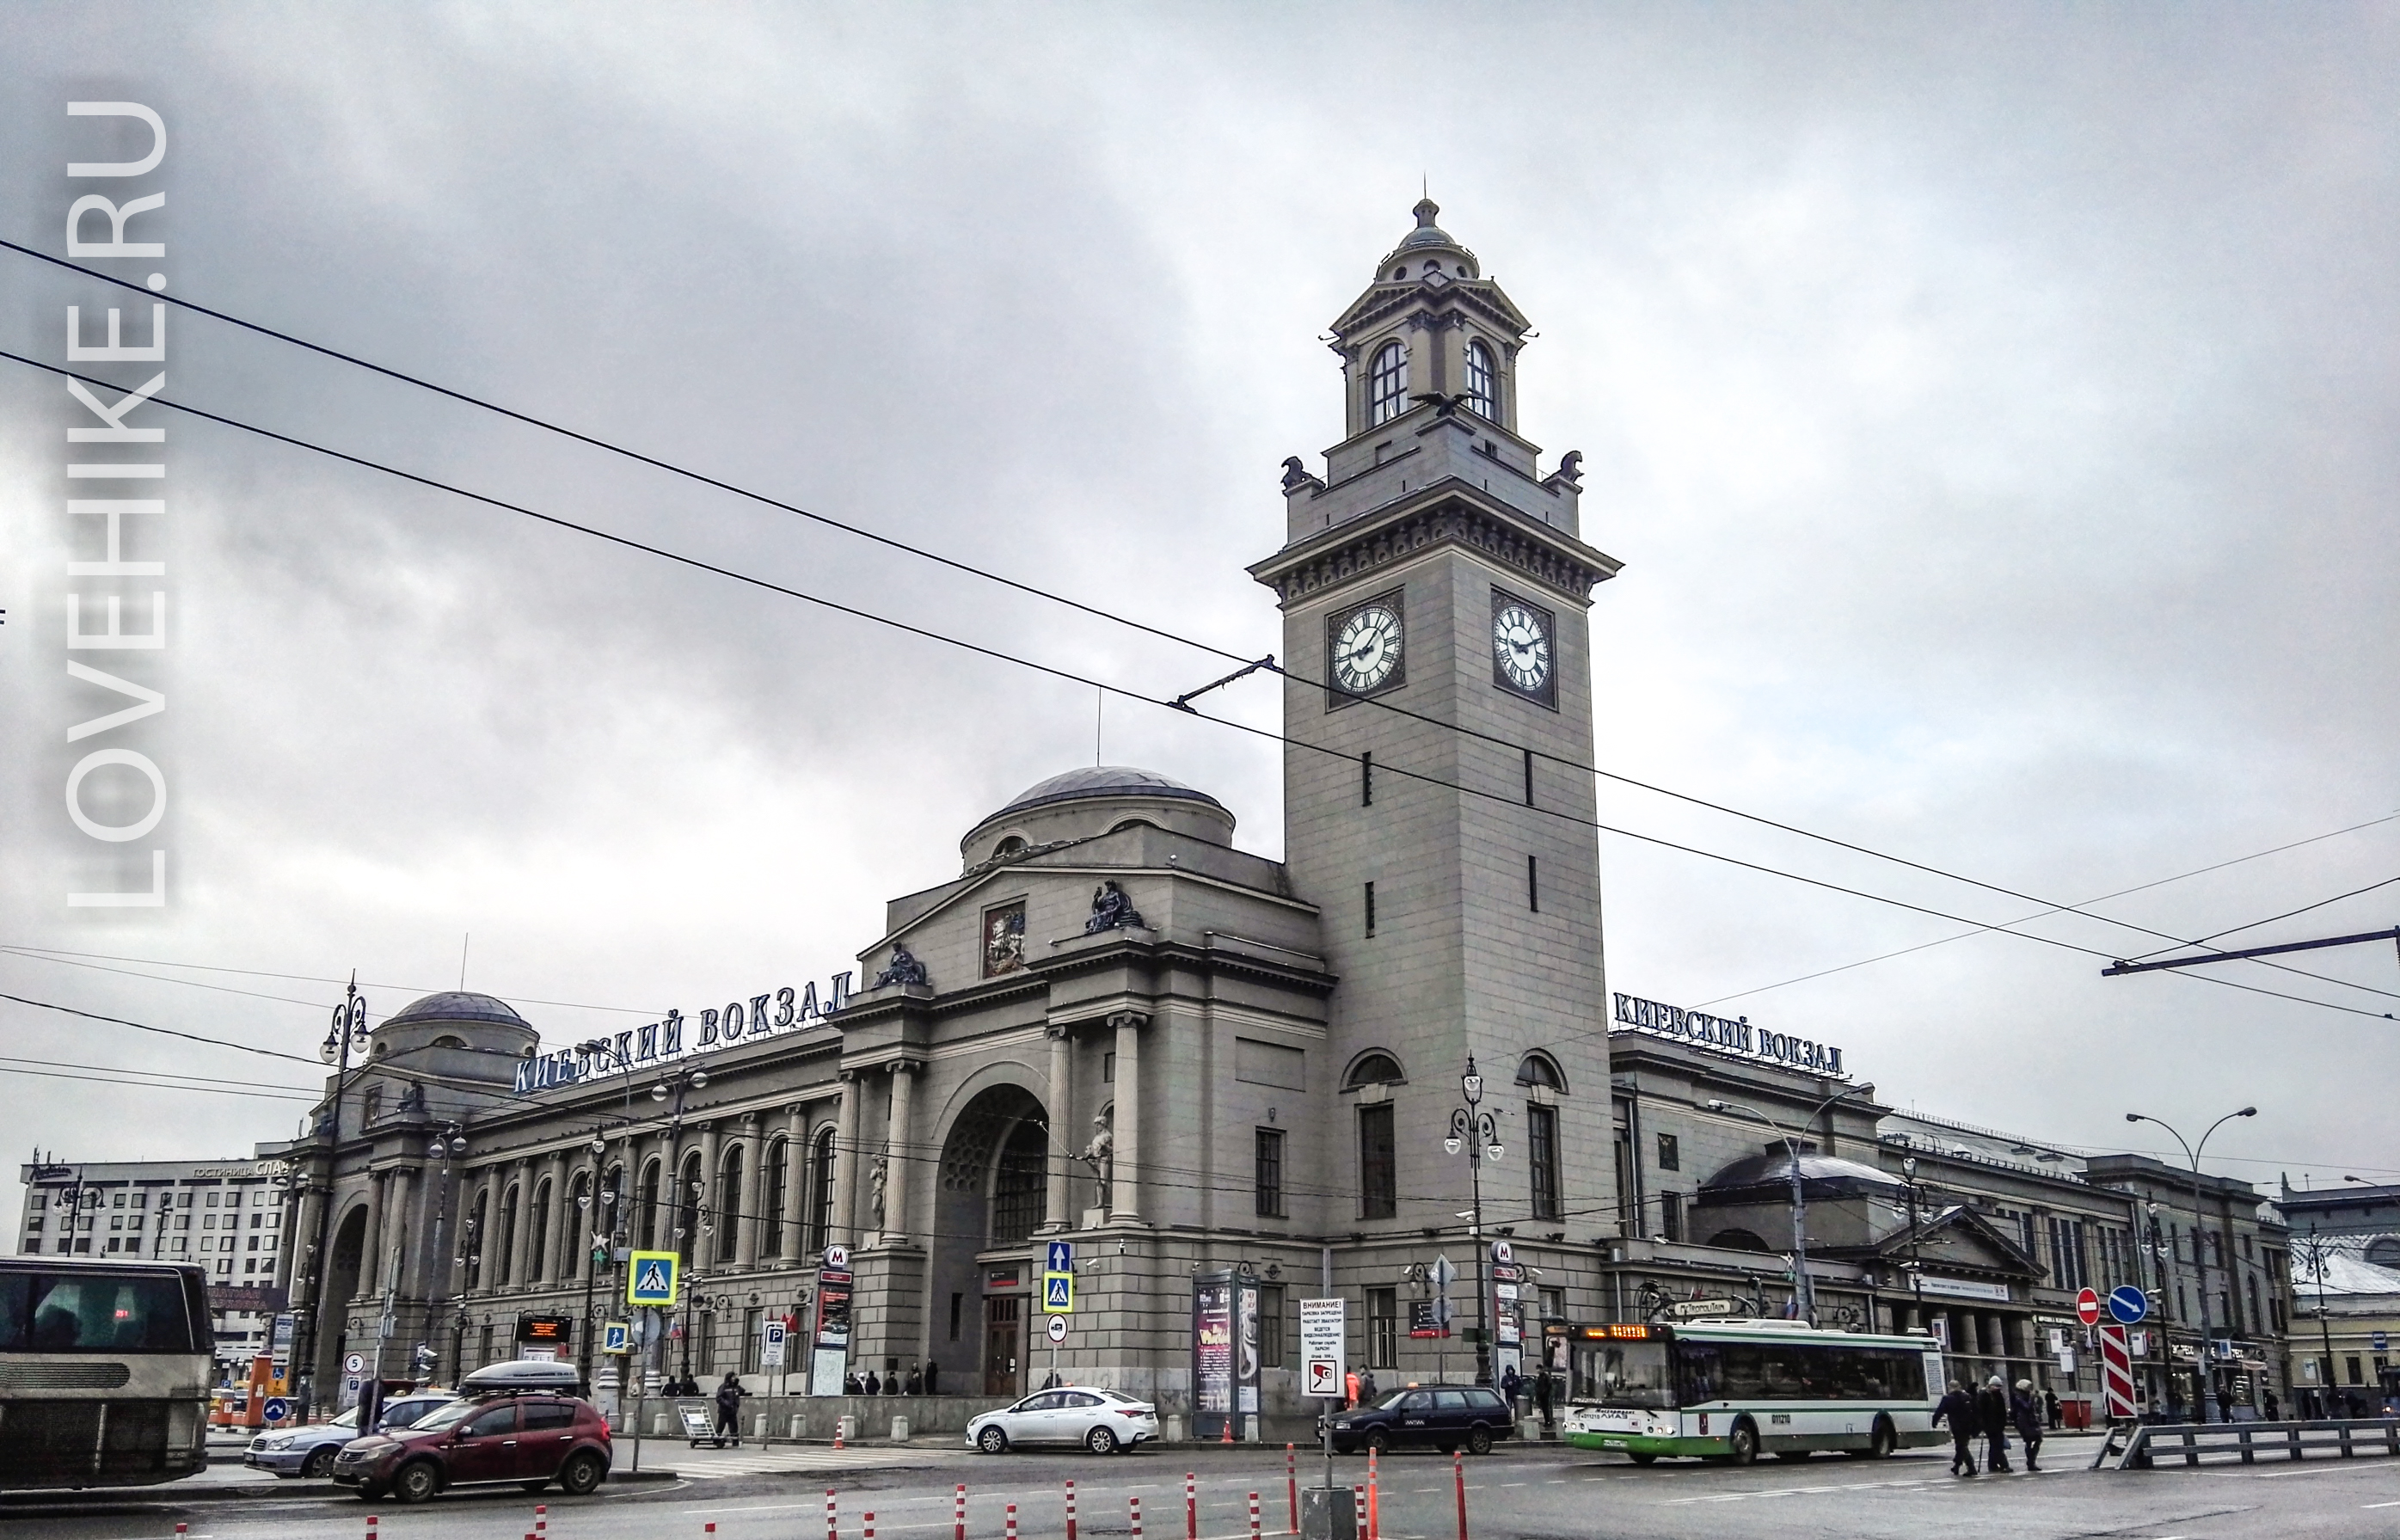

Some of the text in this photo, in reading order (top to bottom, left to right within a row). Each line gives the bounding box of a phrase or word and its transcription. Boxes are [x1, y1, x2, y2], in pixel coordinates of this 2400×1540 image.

[513, 971, 852, 1093] КИЕВСКИЙ ВОКЗАЛ
[1613, 992, 1844, 1074] КИЕВСКИЙ ВОКЗАЛ
[193, 1167, 255, 1178] ГОСТИНИЦА
[1303, 1301, 1341, 1310] ВНИМАНИЕ!
[1771, 1414, 1791, 1424] 011210
